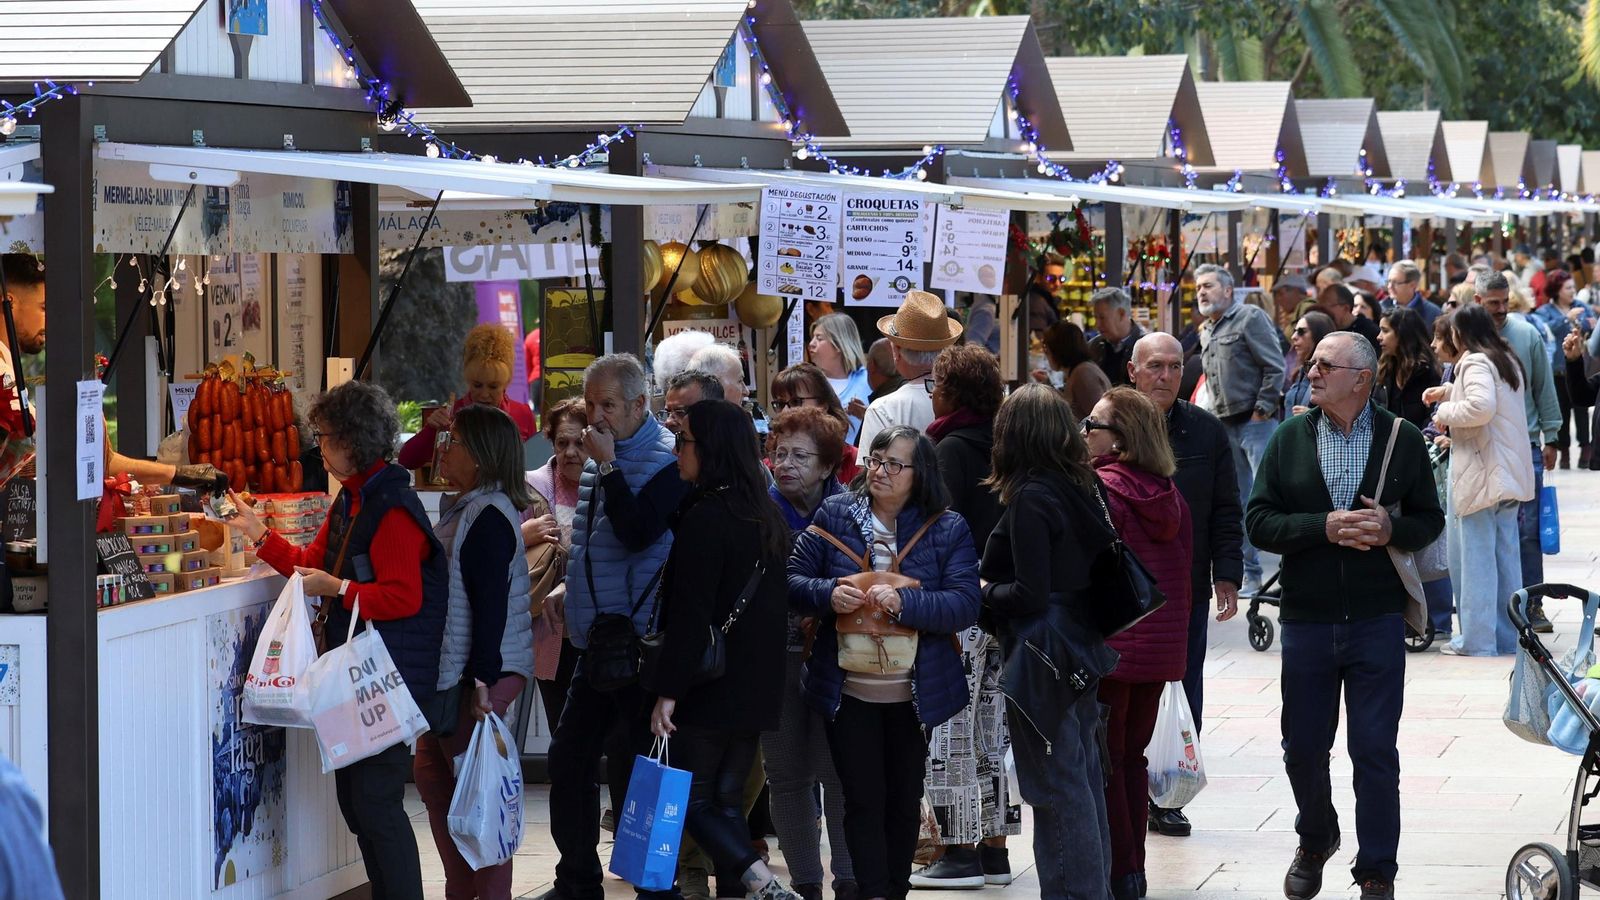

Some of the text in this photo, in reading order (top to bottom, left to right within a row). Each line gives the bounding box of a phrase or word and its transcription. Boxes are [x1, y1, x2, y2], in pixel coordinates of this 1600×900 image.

[768, 187, 836, 202] MENÚ DEGUSTACIÓN
[847, 198, 919, 210] CROQUETAS
[134, 212, 175, 232] VÉLEZ-MÁLAG
[355, 669, 404, 706] MAKE
[360, 703, 386, 727] UP
